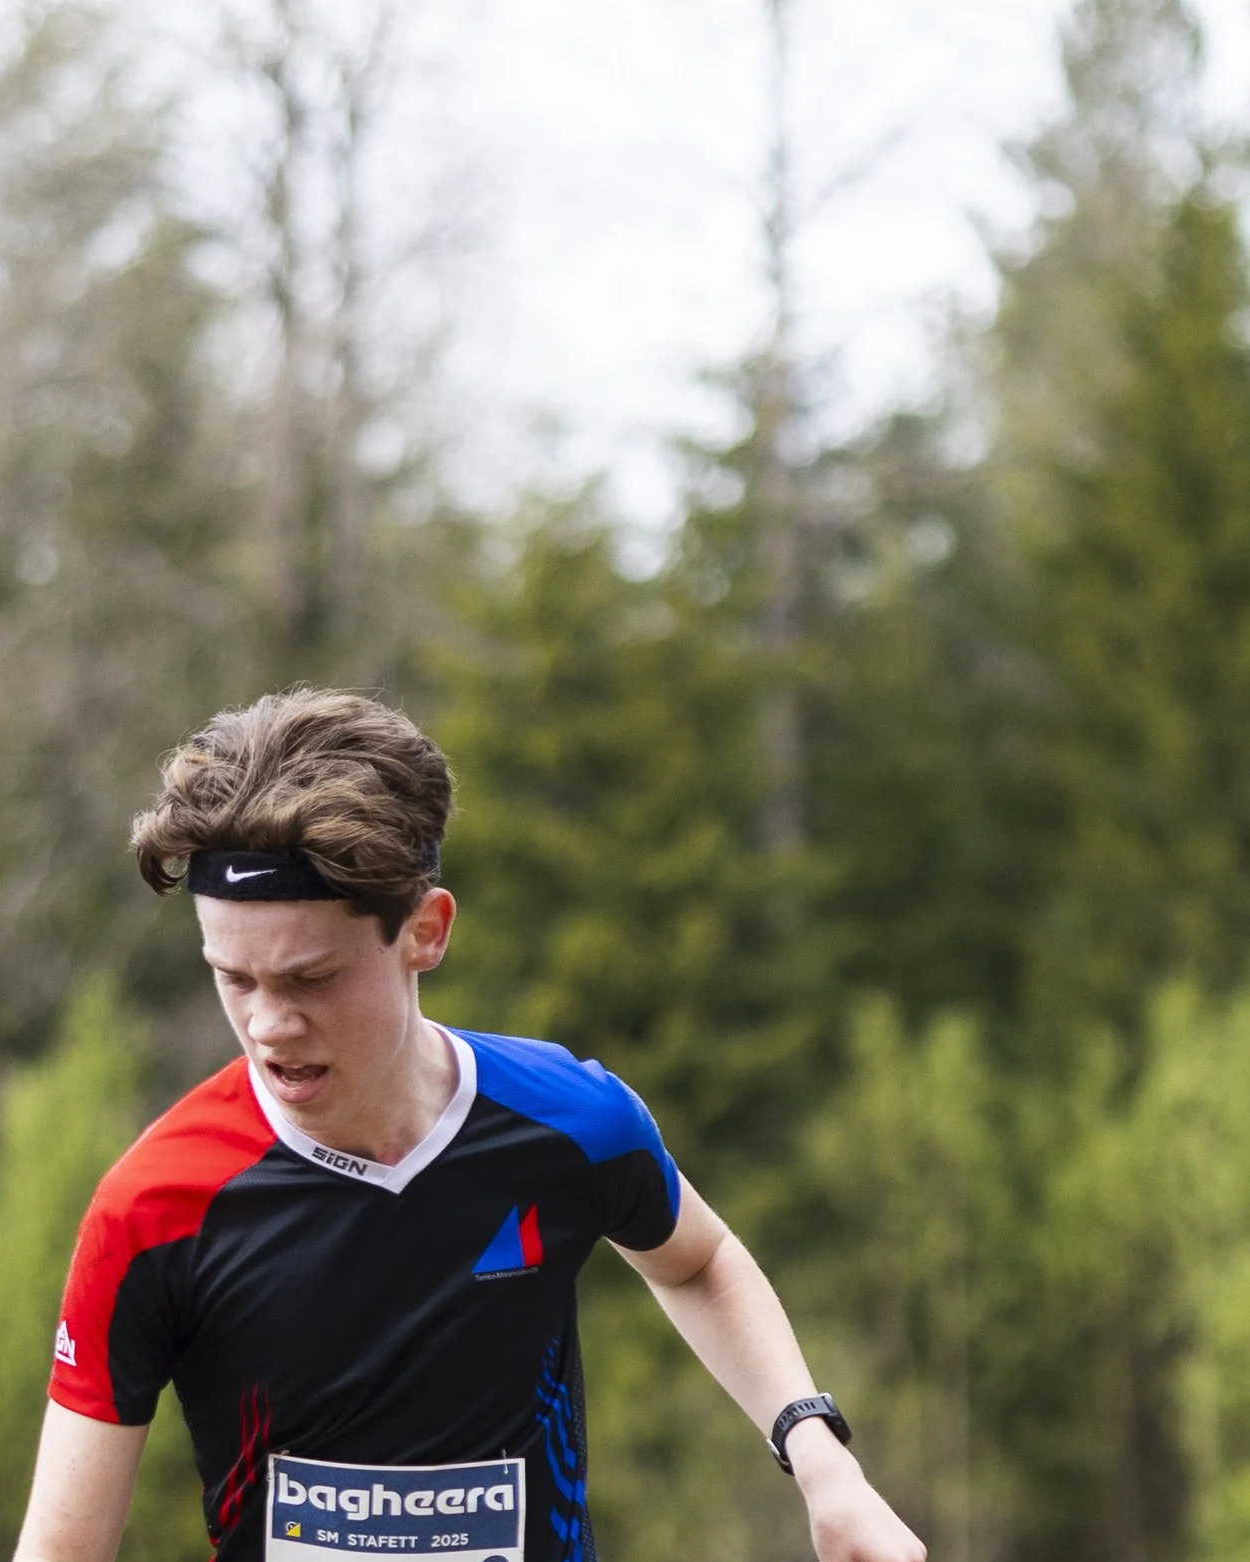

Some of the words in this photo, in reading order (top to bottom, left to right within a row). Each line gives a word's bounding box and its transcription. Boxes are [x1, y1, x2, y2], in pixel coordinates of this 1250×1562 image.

[277, 1472, 515, 1521] bagheera
[317, 1529, 339, 1544] SM
[347, 1533, 419, 1549] STAFETT
[430, 1532, 470, 1548] 2025
